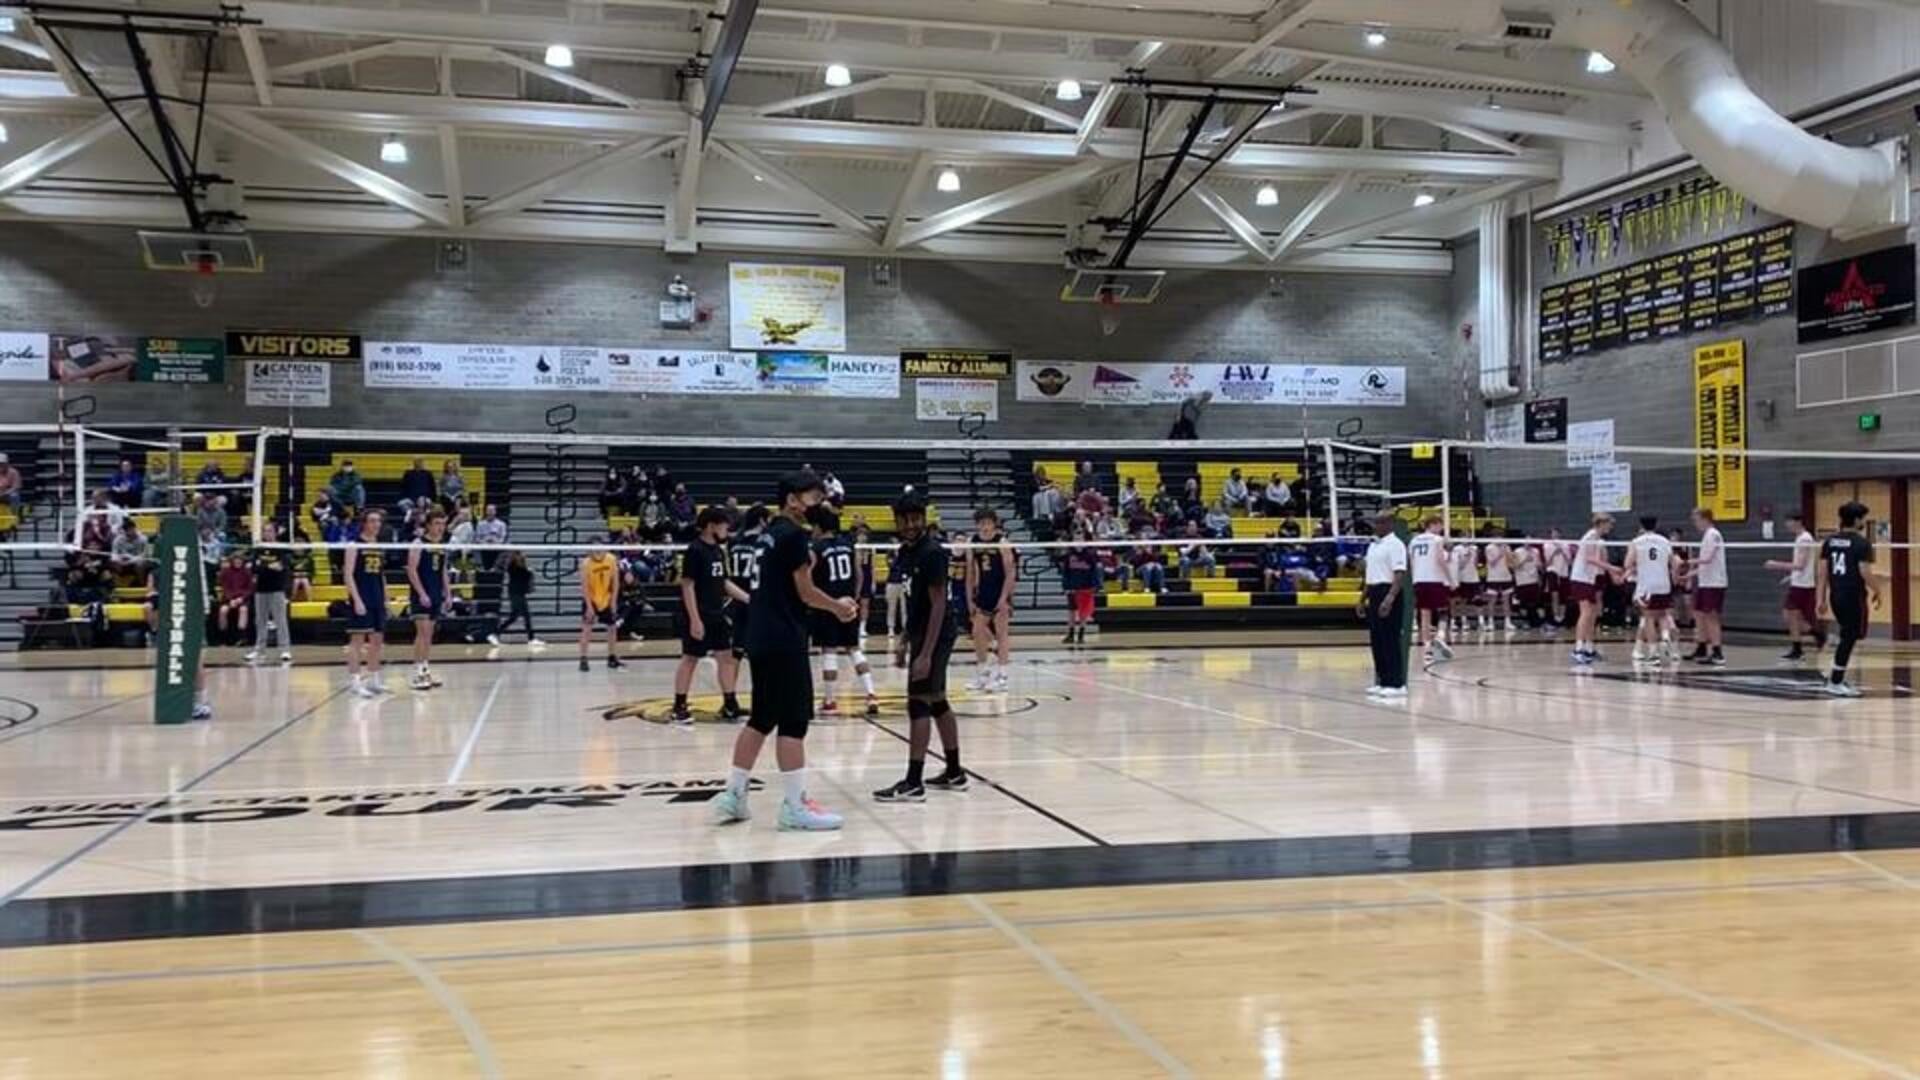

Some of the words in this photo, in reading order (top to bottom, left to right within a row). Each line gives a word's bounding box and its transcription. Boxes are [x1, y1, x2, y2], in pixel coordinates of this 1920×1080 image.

[240, 336, 350, 355] VISITORS
[270, 363, 323, 374] CAMDEN
[905, 361, 949, 373] FAMILY
[733, 552, 753, 577] 17
[1649, 548, 1657, 560] 6
[1831, 551, 1846, 575] 14
[828, 554, 852, 581] 10
[168, 545, 188, 684] VOLLEYBALL
